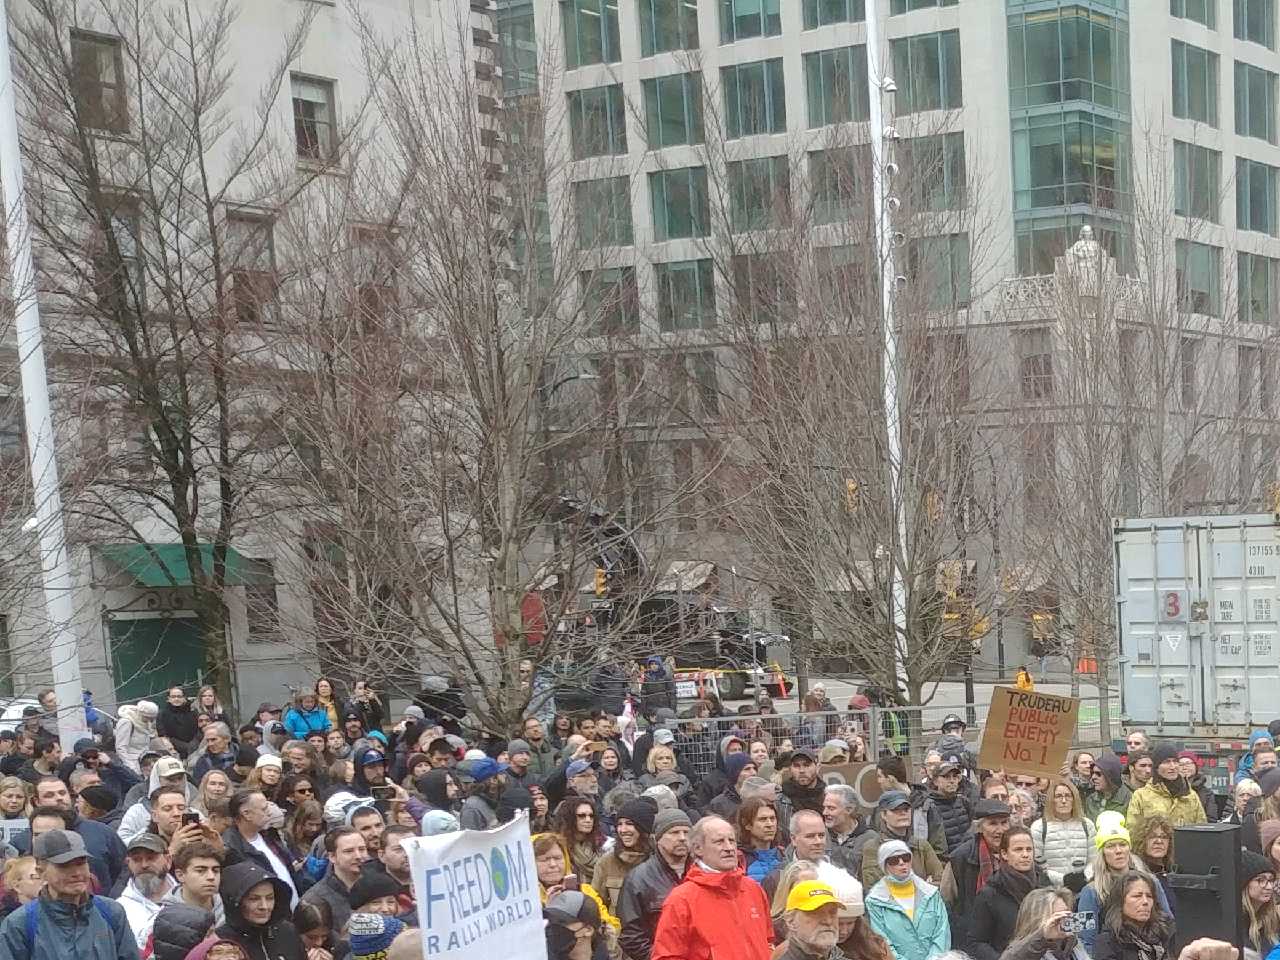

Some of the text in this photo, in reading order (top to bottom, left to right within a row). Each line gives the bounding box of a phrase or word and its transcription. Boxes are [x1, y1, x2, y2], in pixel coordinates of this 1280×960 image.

[1166, 592, 1181, 617] 3
[1006, 691, 1072, 713] TRUDEAU
[1009, 708, 1058, 726] PUBLIC
[1003, 723, 1060, 744] ENEMY
[1040, 746, 1048, 765] 1
[427, 899, 533, 955] RALLY.WORLD
